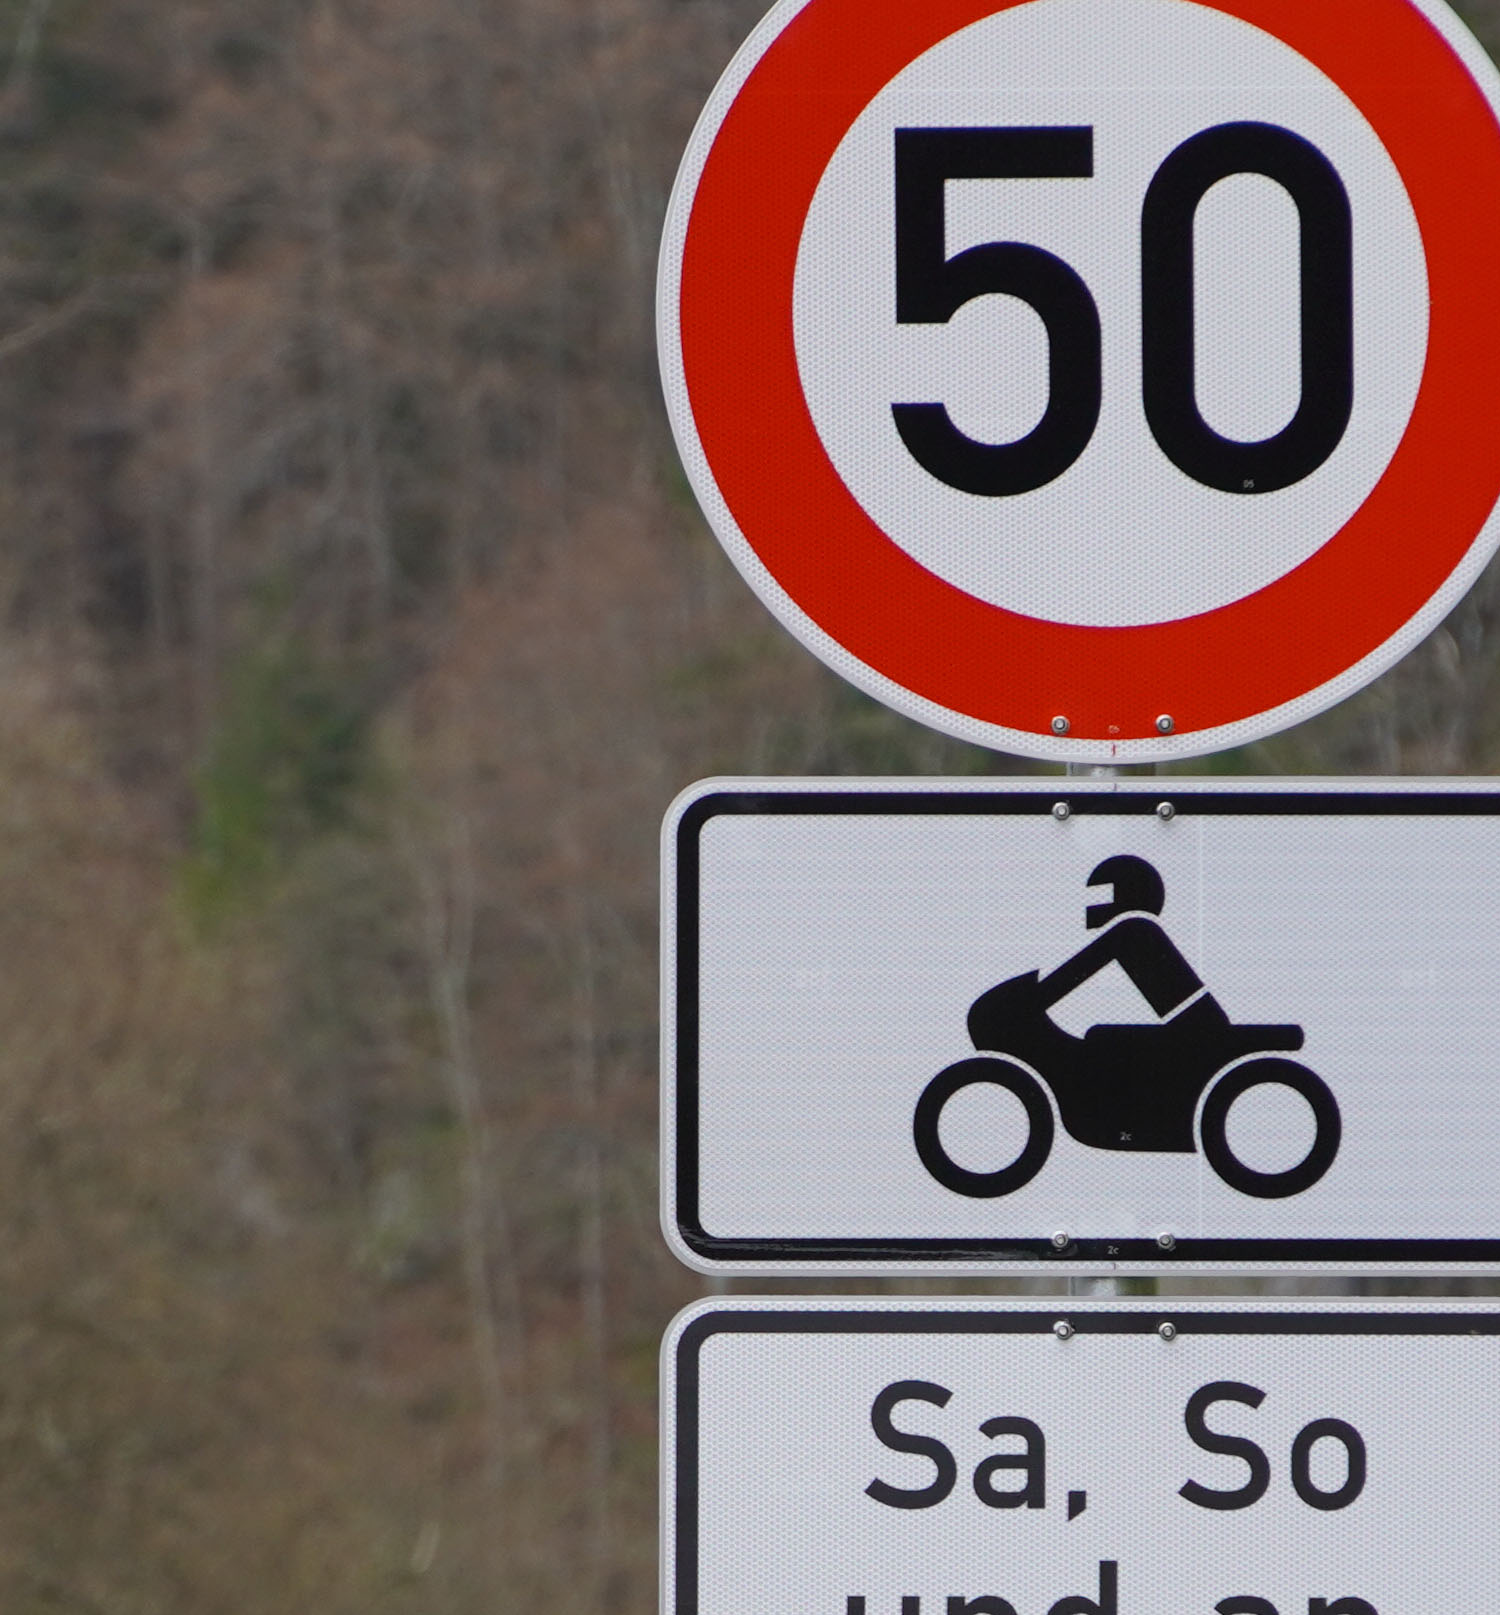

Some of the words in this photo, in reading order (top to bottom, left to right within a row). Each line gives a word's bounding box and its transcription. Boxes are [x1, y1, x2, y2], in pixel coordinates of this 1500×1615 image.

[890, 120, 1354, 498] 50
[864, 1379, 1087, 1522] Sa,
[1177, 1380, 1367, 1512] So
